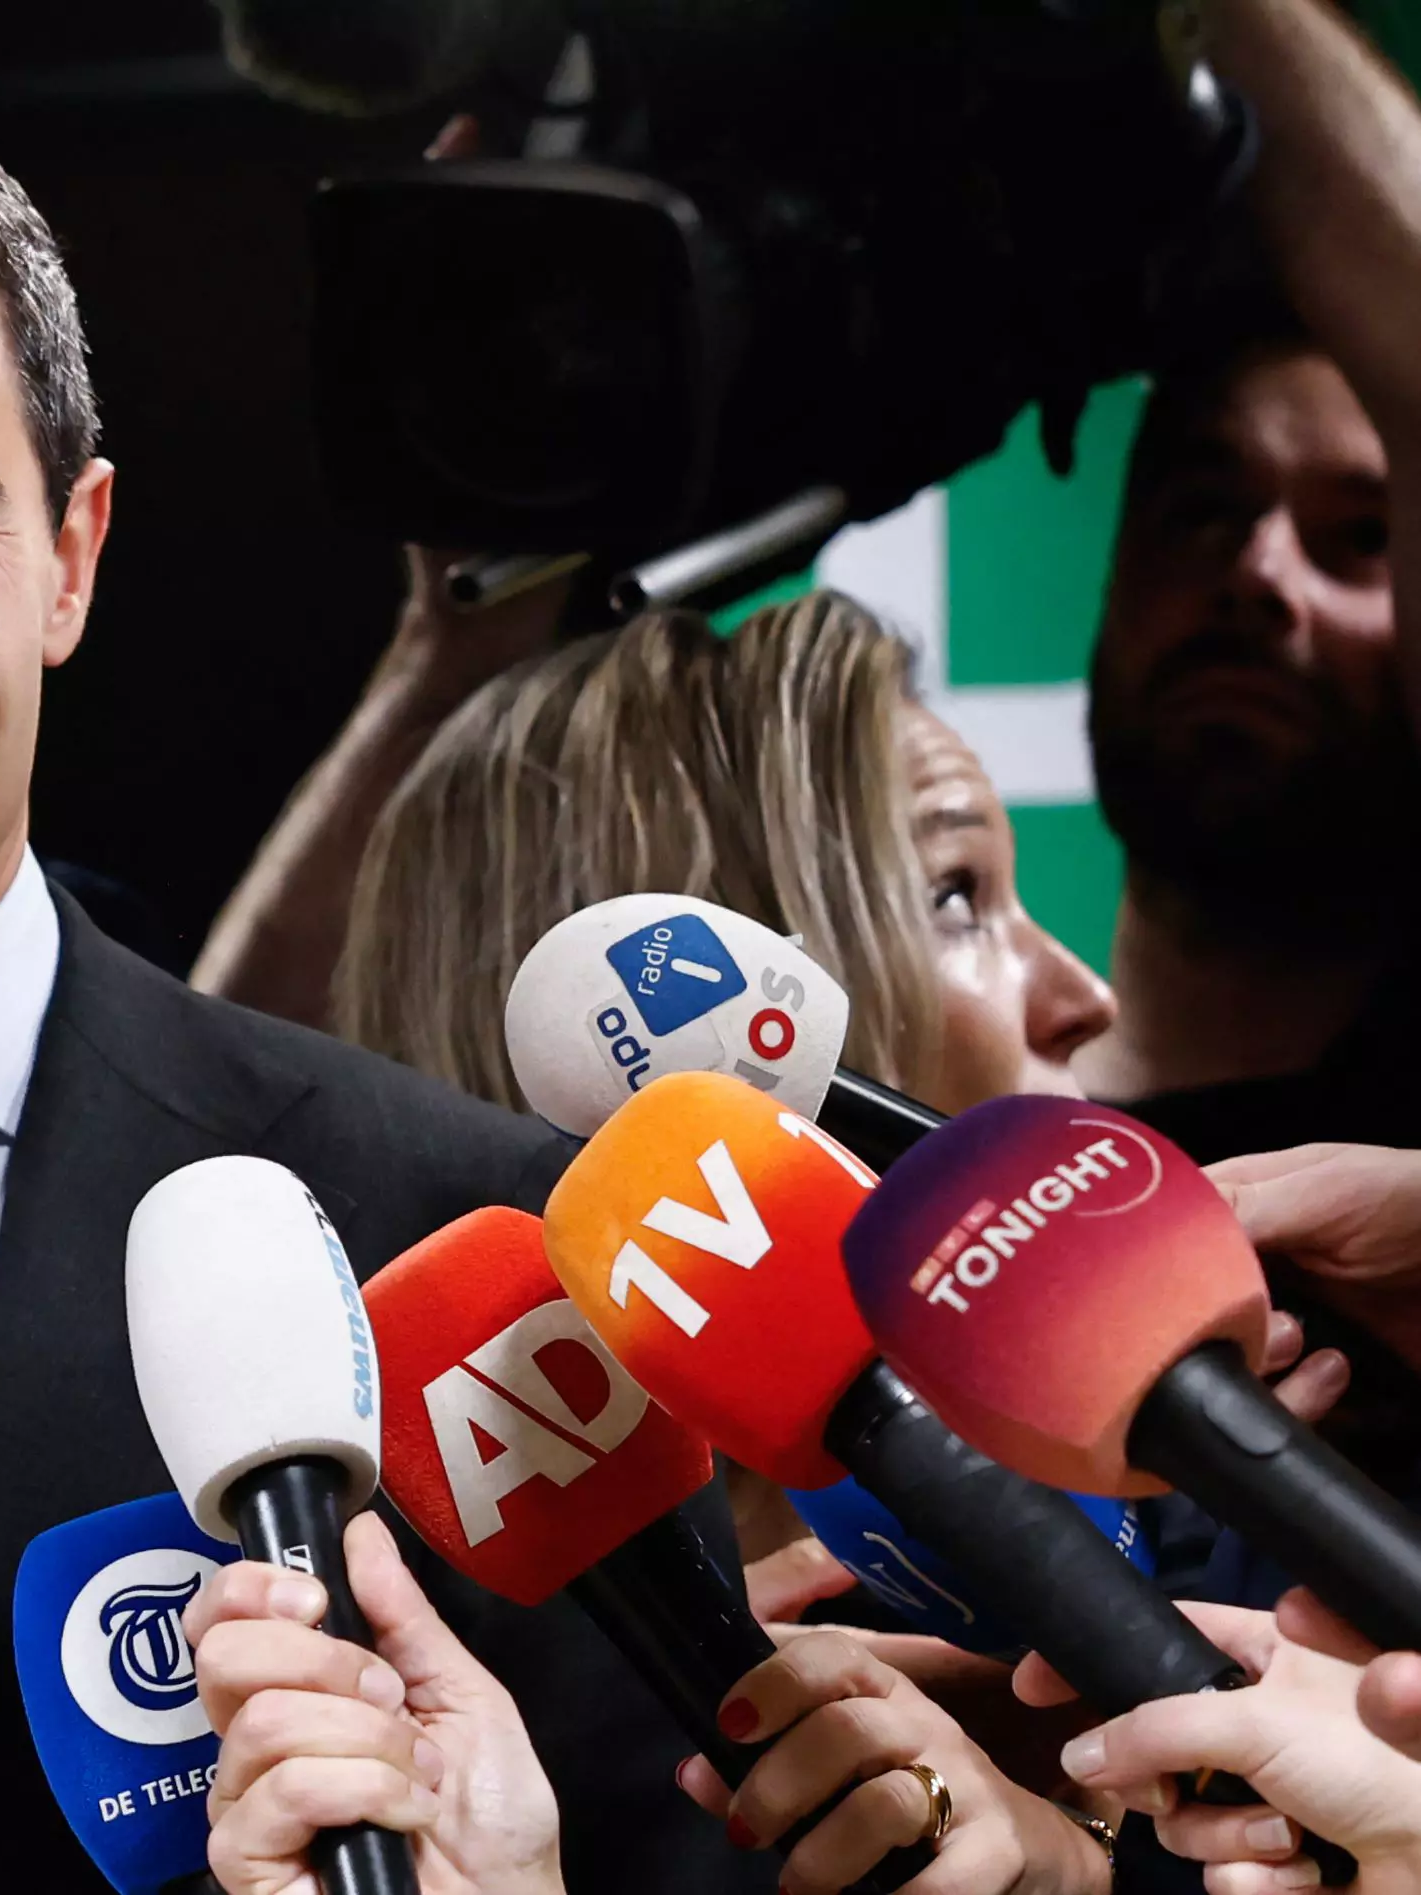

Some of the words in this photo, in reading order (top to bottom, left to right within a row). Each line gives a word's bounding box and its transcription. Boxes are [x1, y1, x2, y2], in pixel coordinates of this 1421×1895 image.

[636, 927, 673, 997] radio
[926, 1137, 1131, 1315] TONIGHT
[421, 1297, 651, 1549] AD
[98, 1789, 137, 1823] DE
